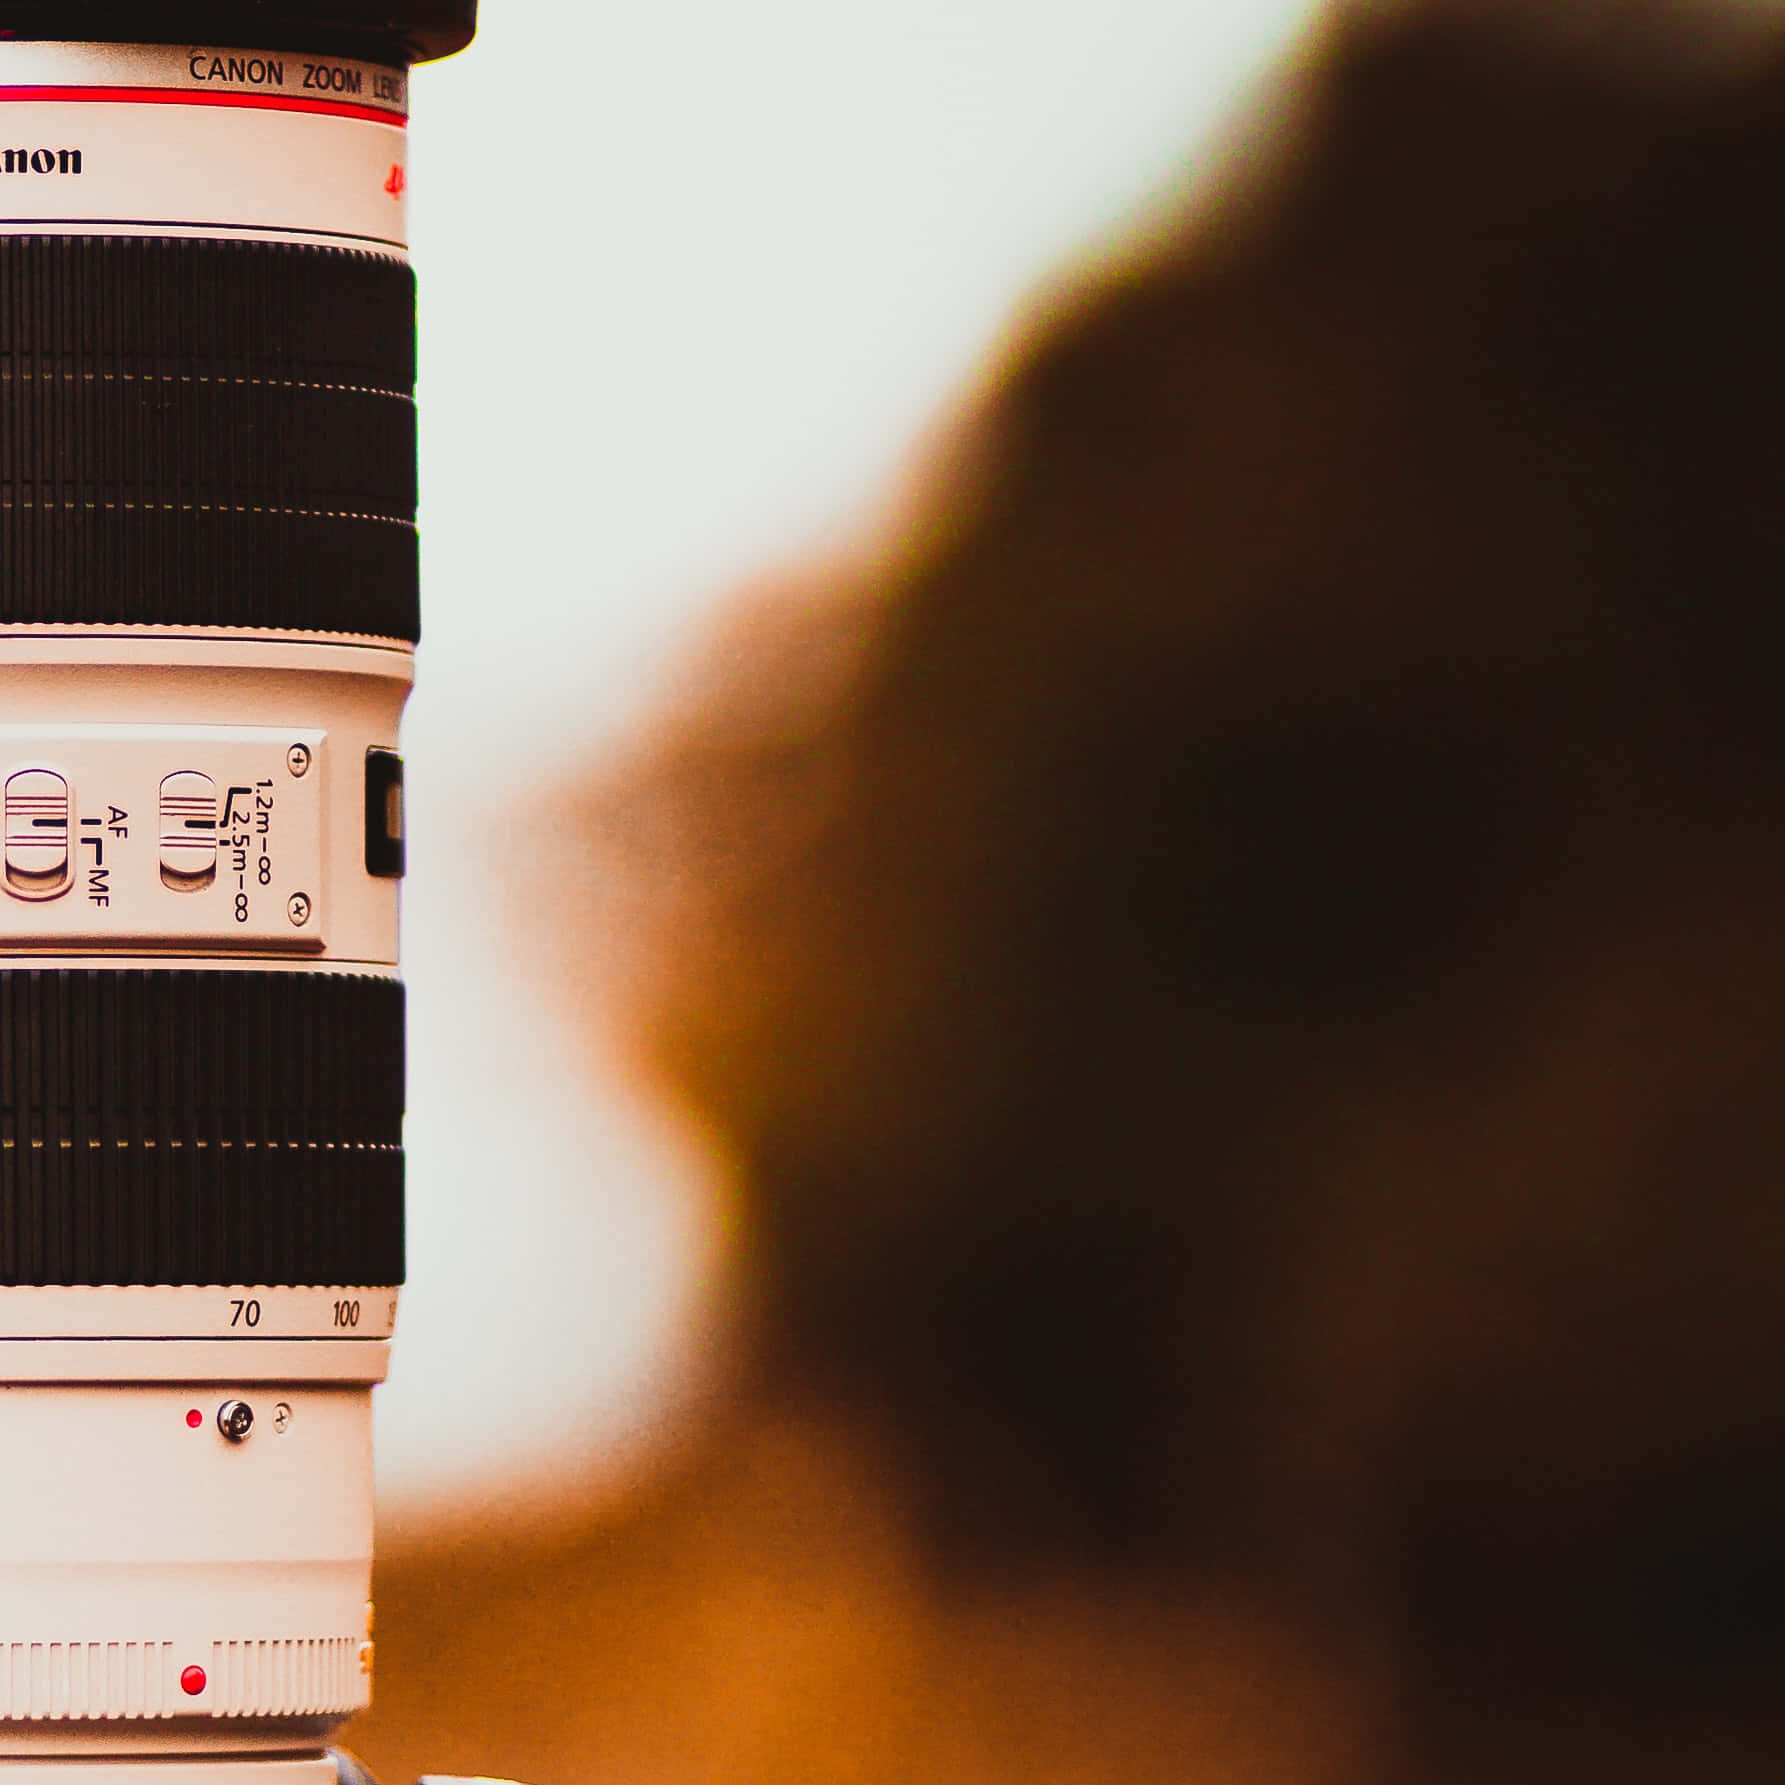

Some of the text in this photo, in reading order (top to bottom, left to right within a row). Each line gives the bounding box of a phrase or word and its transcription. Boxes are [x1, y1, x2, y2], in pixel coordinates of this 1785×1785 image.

[189, 55, 284, 85] CANON
[302, 63, 362, 94] ZOOM
[107, 805, 129, 839] AF
[88, 869, 110, 908] MF
[230, 1299, 261, 1328] 70
[333, 1299, 360, 1328] 100
